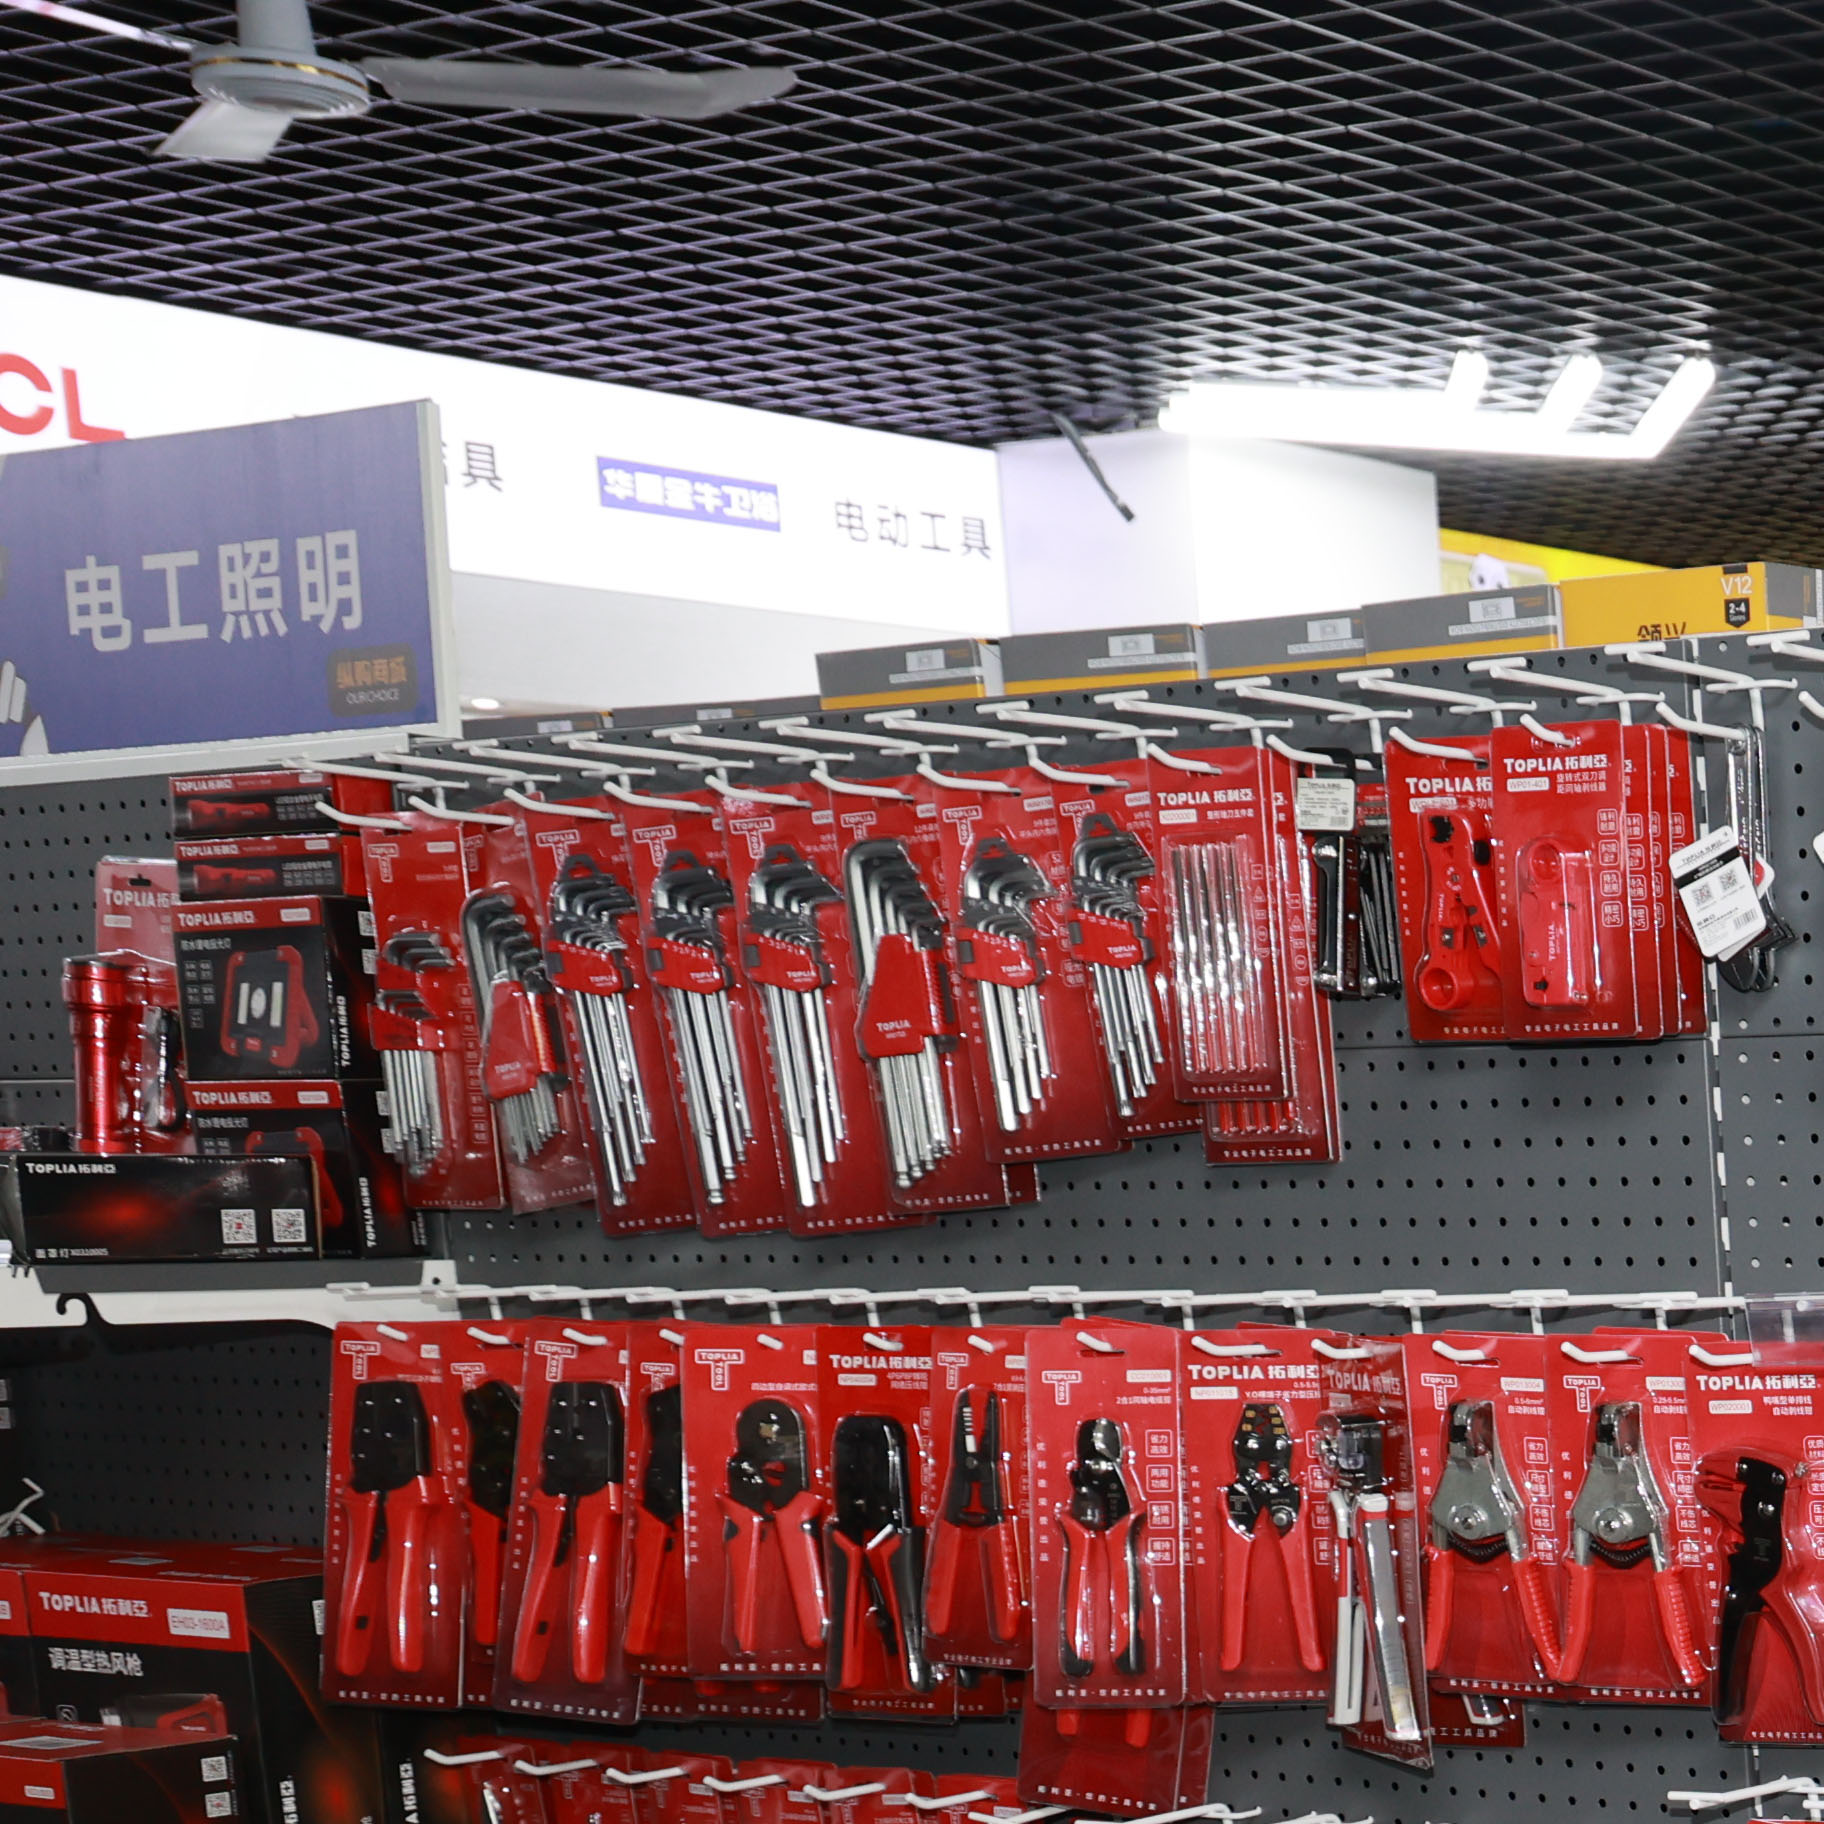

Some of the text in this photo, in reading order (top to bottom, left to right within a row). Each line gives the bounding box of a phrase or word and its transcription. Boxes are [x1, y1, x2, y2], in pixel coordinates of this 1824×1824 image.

[834, 498, 991, 559] 电动工具
[65, 529, 363, 653] 电工照明
[1721, 576, 1752, 595] V12
[1504, 755, 1609, 773] TOPLIA 拓利亞
[1405, 776, 1473, 794] TOPLIA
[1158, 791, 1210, 806] TOPLIA
[104, 888, 155, 908] TOPLIA
[1525, 1022, 1620, 1033] 专业电子电工工具品牌
[25, 1162, 76, 1175] TOPLIA
[343, 1343, 379, 1354] TOPLIA
[538, 1343, 574, 1356] TOPLIA
[698, 1352, 741, 1362] TOPLIA
[830, 1354, 888, 1369] TOPLIA
[713, 1363, 725, 1389] TOOL
[1044, 1372, 1079, 1382] TOPLIA
[1188, 1365, 1263, 1380] TOPLIA
[1423, 1375, 1456, 1386] TOPLIA
[1565, 1376, 1598, 1388] TOPLIA
[1696, 1374, 1818, 1390] TOPLIA 拓利亞
[1057, 1382, 1067, 1403] TOOL
[1435, 1387, 1446, 1410] TOOL
[1578, 1388, 1588, 1411] TOOL
[38, 1591, 149, 1618] TOPLIA 拓利亞
[48, 1647, 144, 1677] 调温型热风枪
